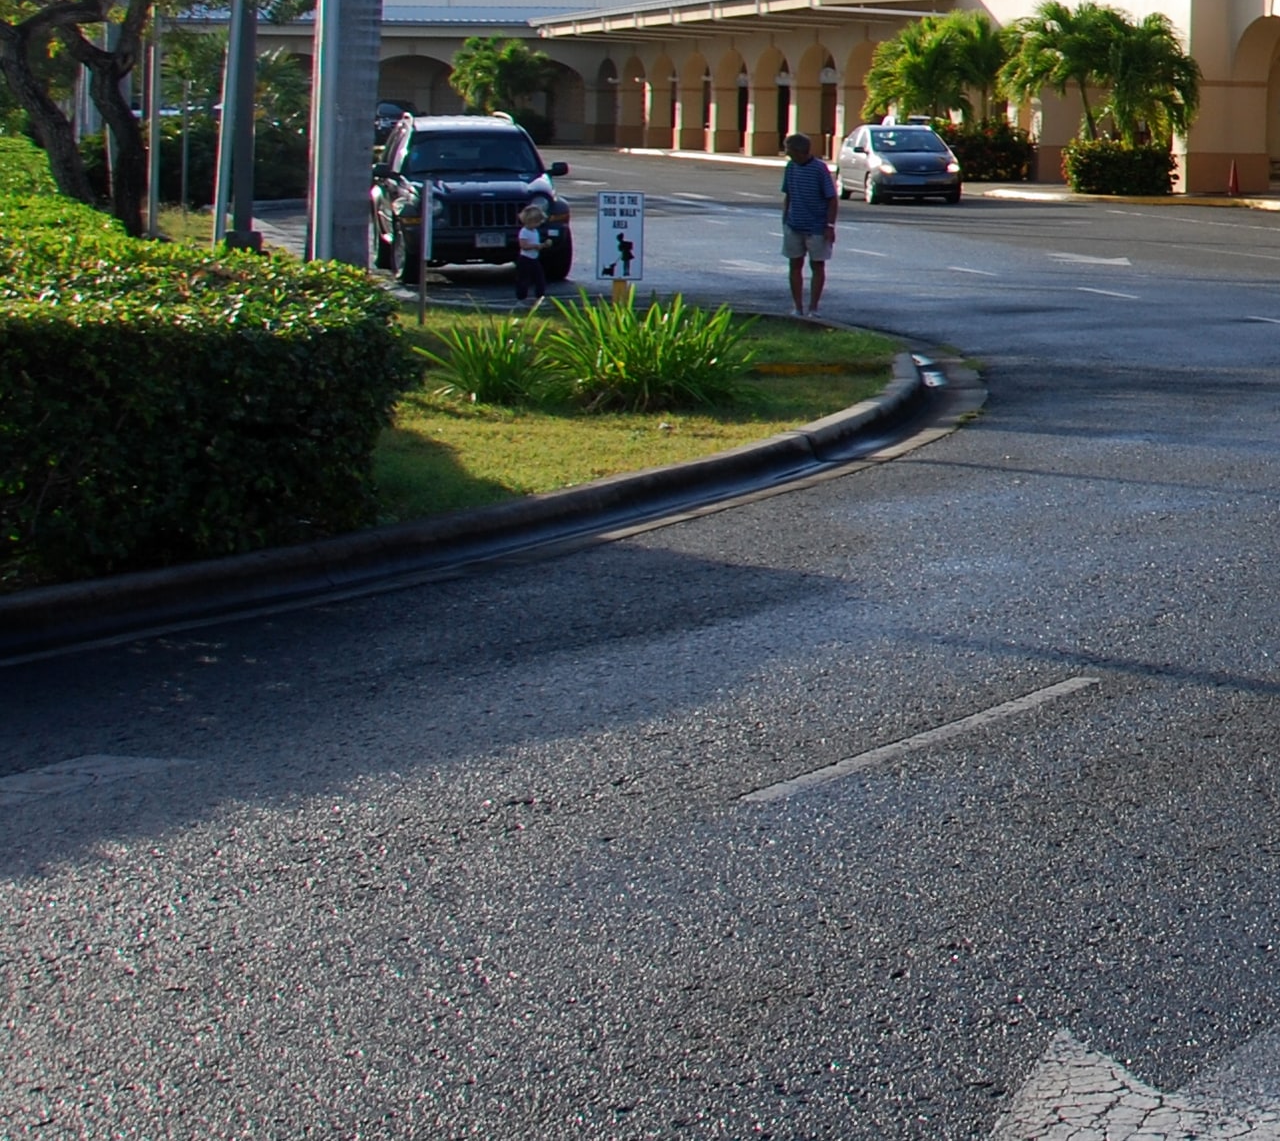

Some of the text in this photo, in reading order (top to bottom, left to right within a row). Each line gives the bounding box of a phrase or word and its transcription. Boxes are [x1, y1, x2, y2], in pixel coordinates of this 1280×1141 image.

[603, 195, 638, 206] THIS IS THE
[612, 220, 628, 229] AREA
